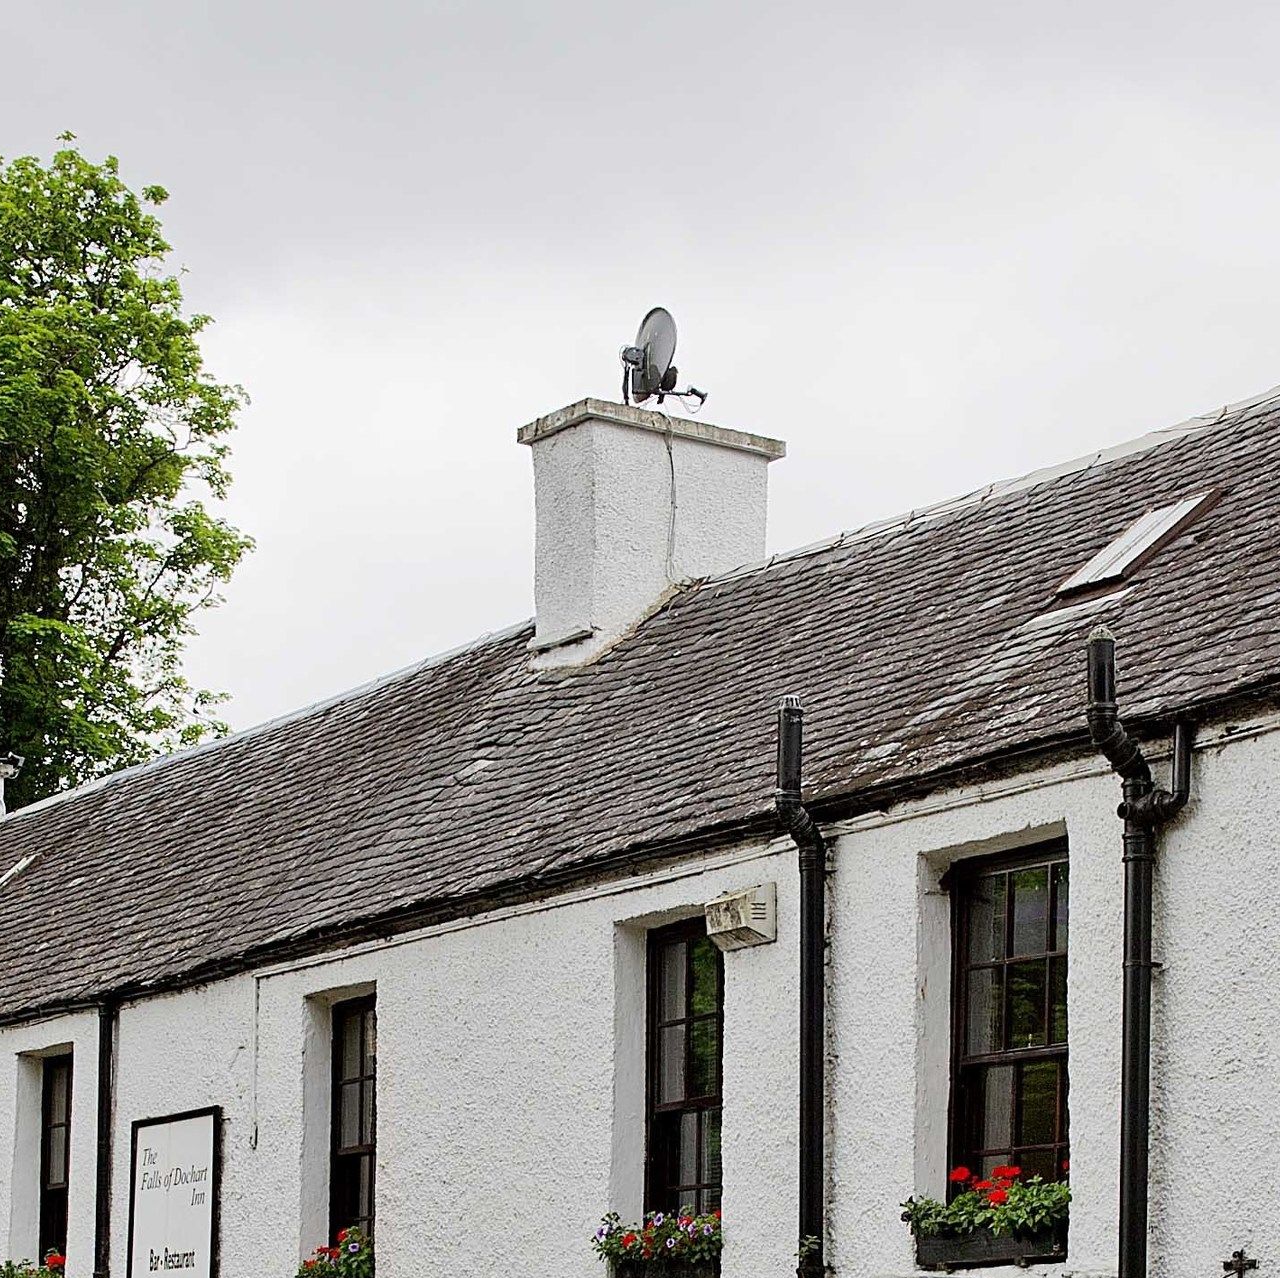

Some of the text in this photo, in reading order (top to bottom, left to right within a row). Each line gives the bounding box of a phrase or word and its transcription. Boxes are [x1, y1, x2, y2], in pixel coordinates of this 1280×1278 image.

[143, 1148, 158, 1166] The
[141, 1165, 208, 1193] Falls of Dochart
[191, 1188, 205, 1206] Inn
[149, 1249, 160, 1271] Bar
[163, 1247, 195, 1270] Restaurant
